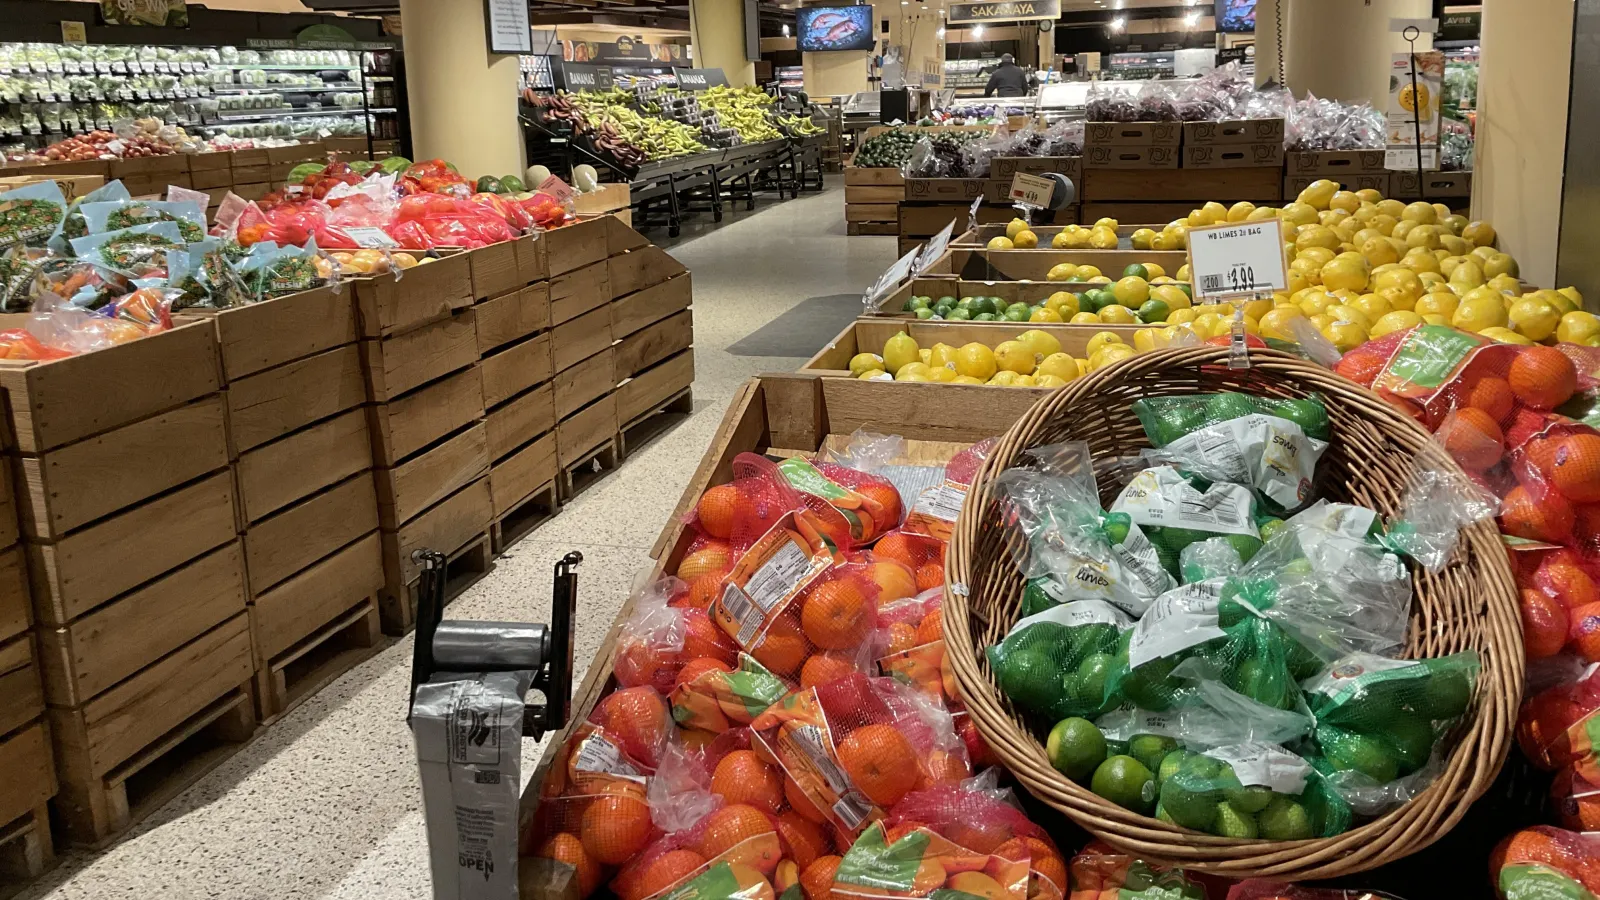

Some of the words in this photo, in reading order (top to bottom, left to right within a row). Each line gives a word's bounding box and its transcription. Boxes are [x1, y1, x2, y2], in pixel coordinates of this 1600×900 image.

[971, 4, 1035, 17] SAKANAYA
[1221, 50, 1243, 58] SCALE
[570, 72, 596, 85] BANANAS
[680, 74, 707, 84] BANANAS
[1219, 230, 1238, 239] LIMES
[1248, 227, 1262, 236] BAG
[1273, 435, 1298, 458] limes
[1125, 486, 1147, 498] limes
[1075, 566, 1109, 587] limes
[459, 725, 467, 761] PLASTIC
[458, 855, 494, 873] OPEN
